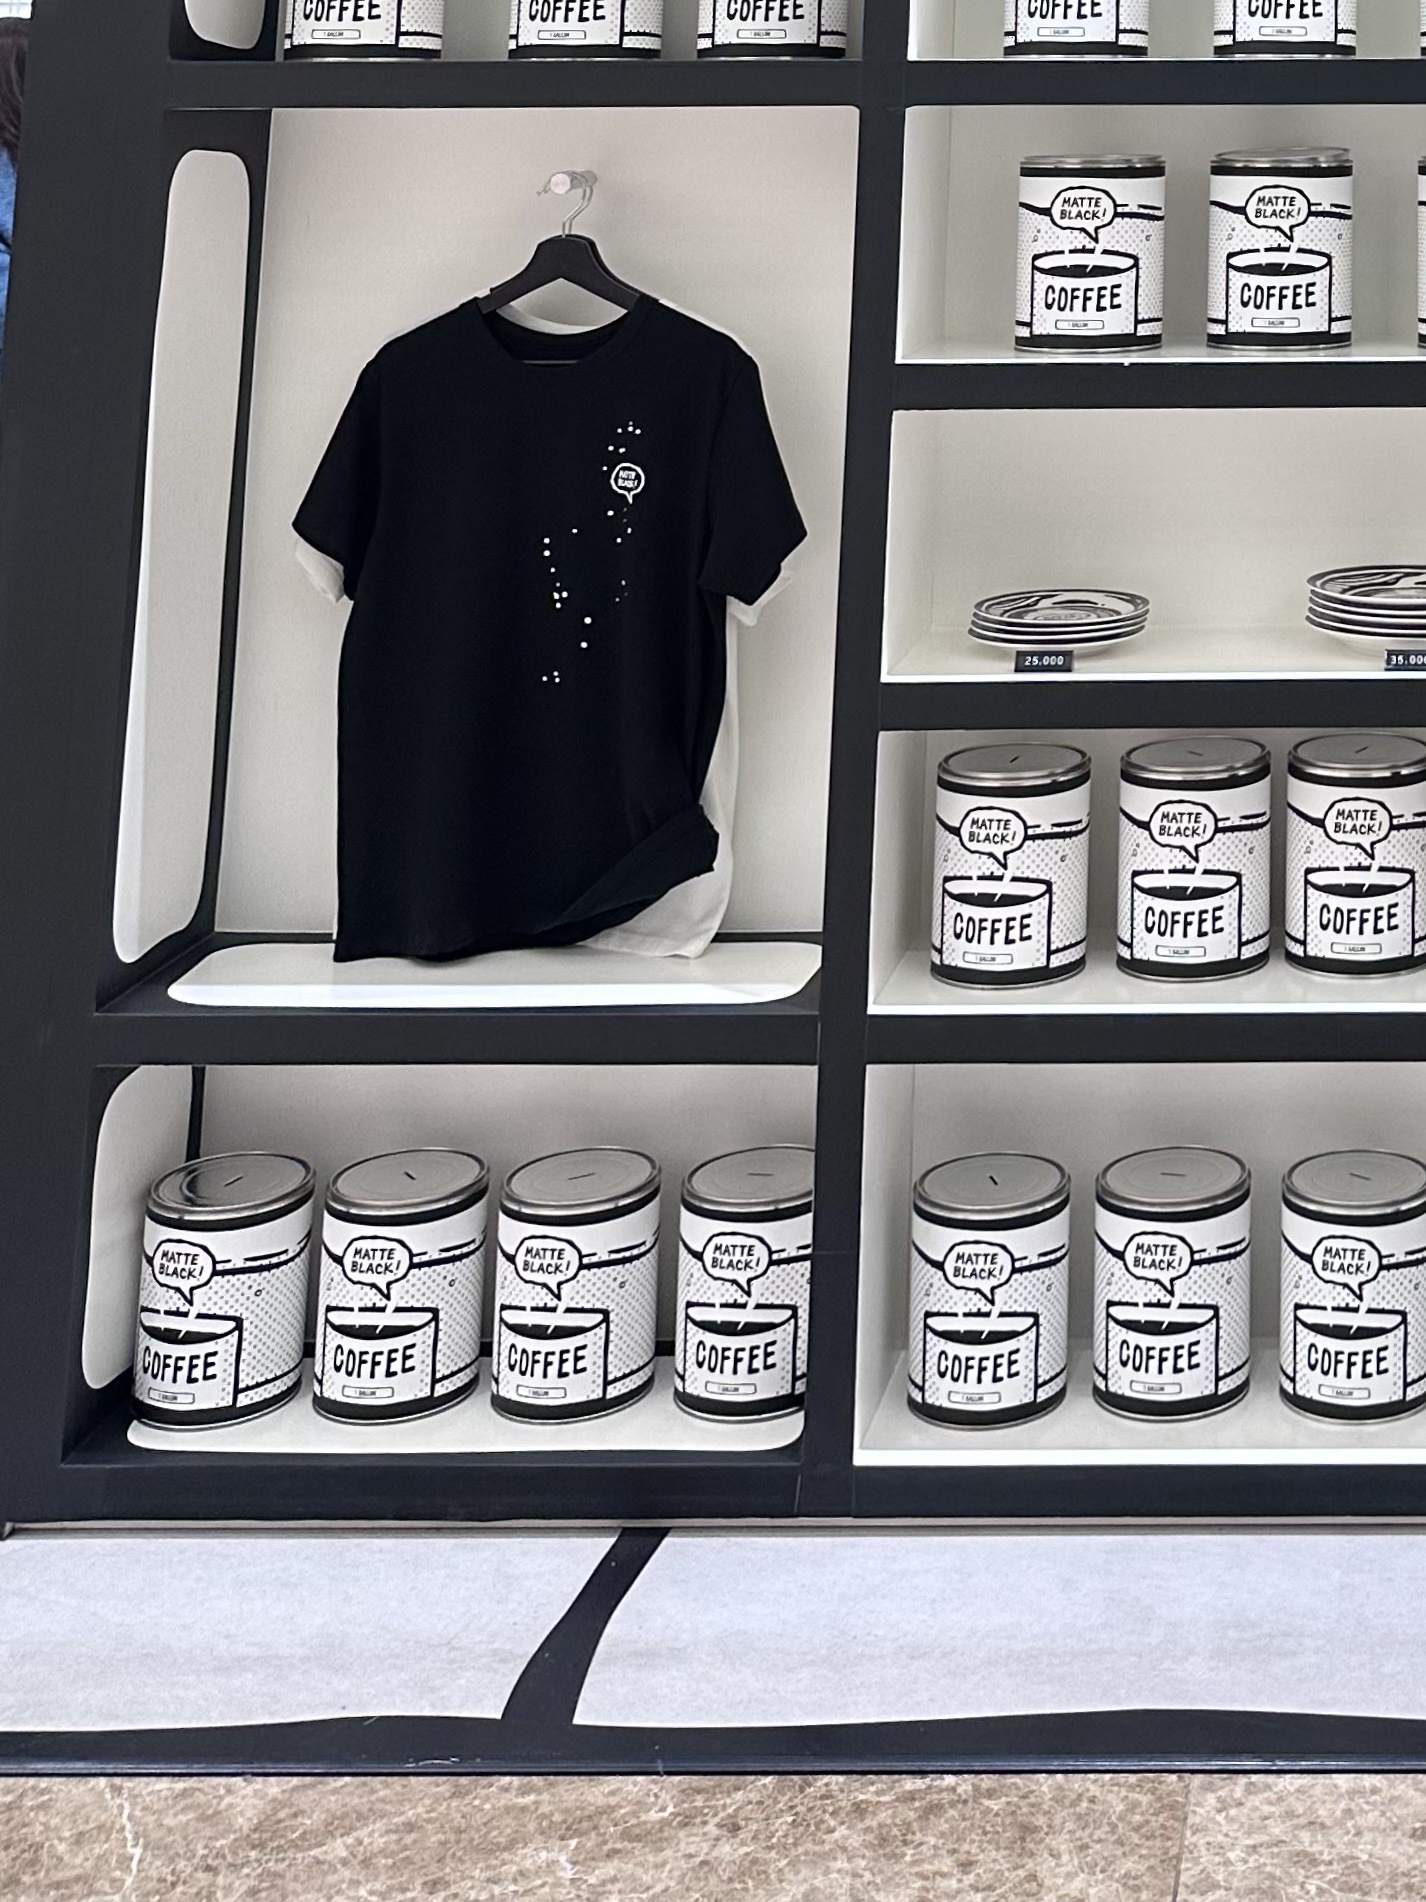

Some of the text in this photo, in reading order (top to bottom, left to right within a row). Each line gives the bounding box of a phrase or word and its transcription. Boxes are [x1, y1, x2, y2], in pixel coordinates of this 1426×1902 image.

[1062, 197, 1102, 207] MATTE
[1256, 196, 1296, 207] MATTE
[1060, 208, 1106, 220] BLACK!
[1255, 207, 1301, 219] BLACK!
[1045, 283, 1122, 312] COFFEE
[1240, 282, 1316, 310] COFFEE
[1161, 812, 1202, 824] MATTE
[1336, 809, 1378, 821] MATTE
[970, 818, 1011, 830] MATTE
[1159, 824, 1207, 838] BLACK!
[1334, 821, 1382, 835] BLACK!
[968, 831, 1016, 845] BLACK!
[1145, 905, 1224, 938] COFFEE
[1319, 902, 1399, 935] COFFEE
[953, 912, 1032, 945] COFFEE
[161, 1250, 199, 1265] MATTE
[353, 1248, 396, 1260] MATTE
[525, 1247, 565, 1260] MATTE
[713, 1243, 755, 1257] MATTE
[1135, 1243, 1177, 1257] MATTE
[1323, 1246, 1366, 1261] MATTE
[711, 1257, 760, 1271] BLACK!
[955, 1252, 998, 1265] MATTE
[1133, 1256, 1182, 1271] BLACK!
[159, 1263, 204, 1280] BLACK!
[351, 1260, 401, 1275] BLACK!
[523, 1260, 570, 1275] BLACK!
[953, 1266, 1003, 1280] BLACK!
[1321, 1260, 1371, 1275] BLACK!
[334, 1343, 416, 1379] COFFEE
[508, 1343, 587, 1379] COFFEE
[696, 1340, 777, 1375] COFFEE
[1119, 1339, 1200, 1375] COFFEE
[1308, 1343, 1389, 1379] COFFEE
[142, 1346, 218, 1384] COFFEE
[937, 1348, 1020, 1384] COFFEE
